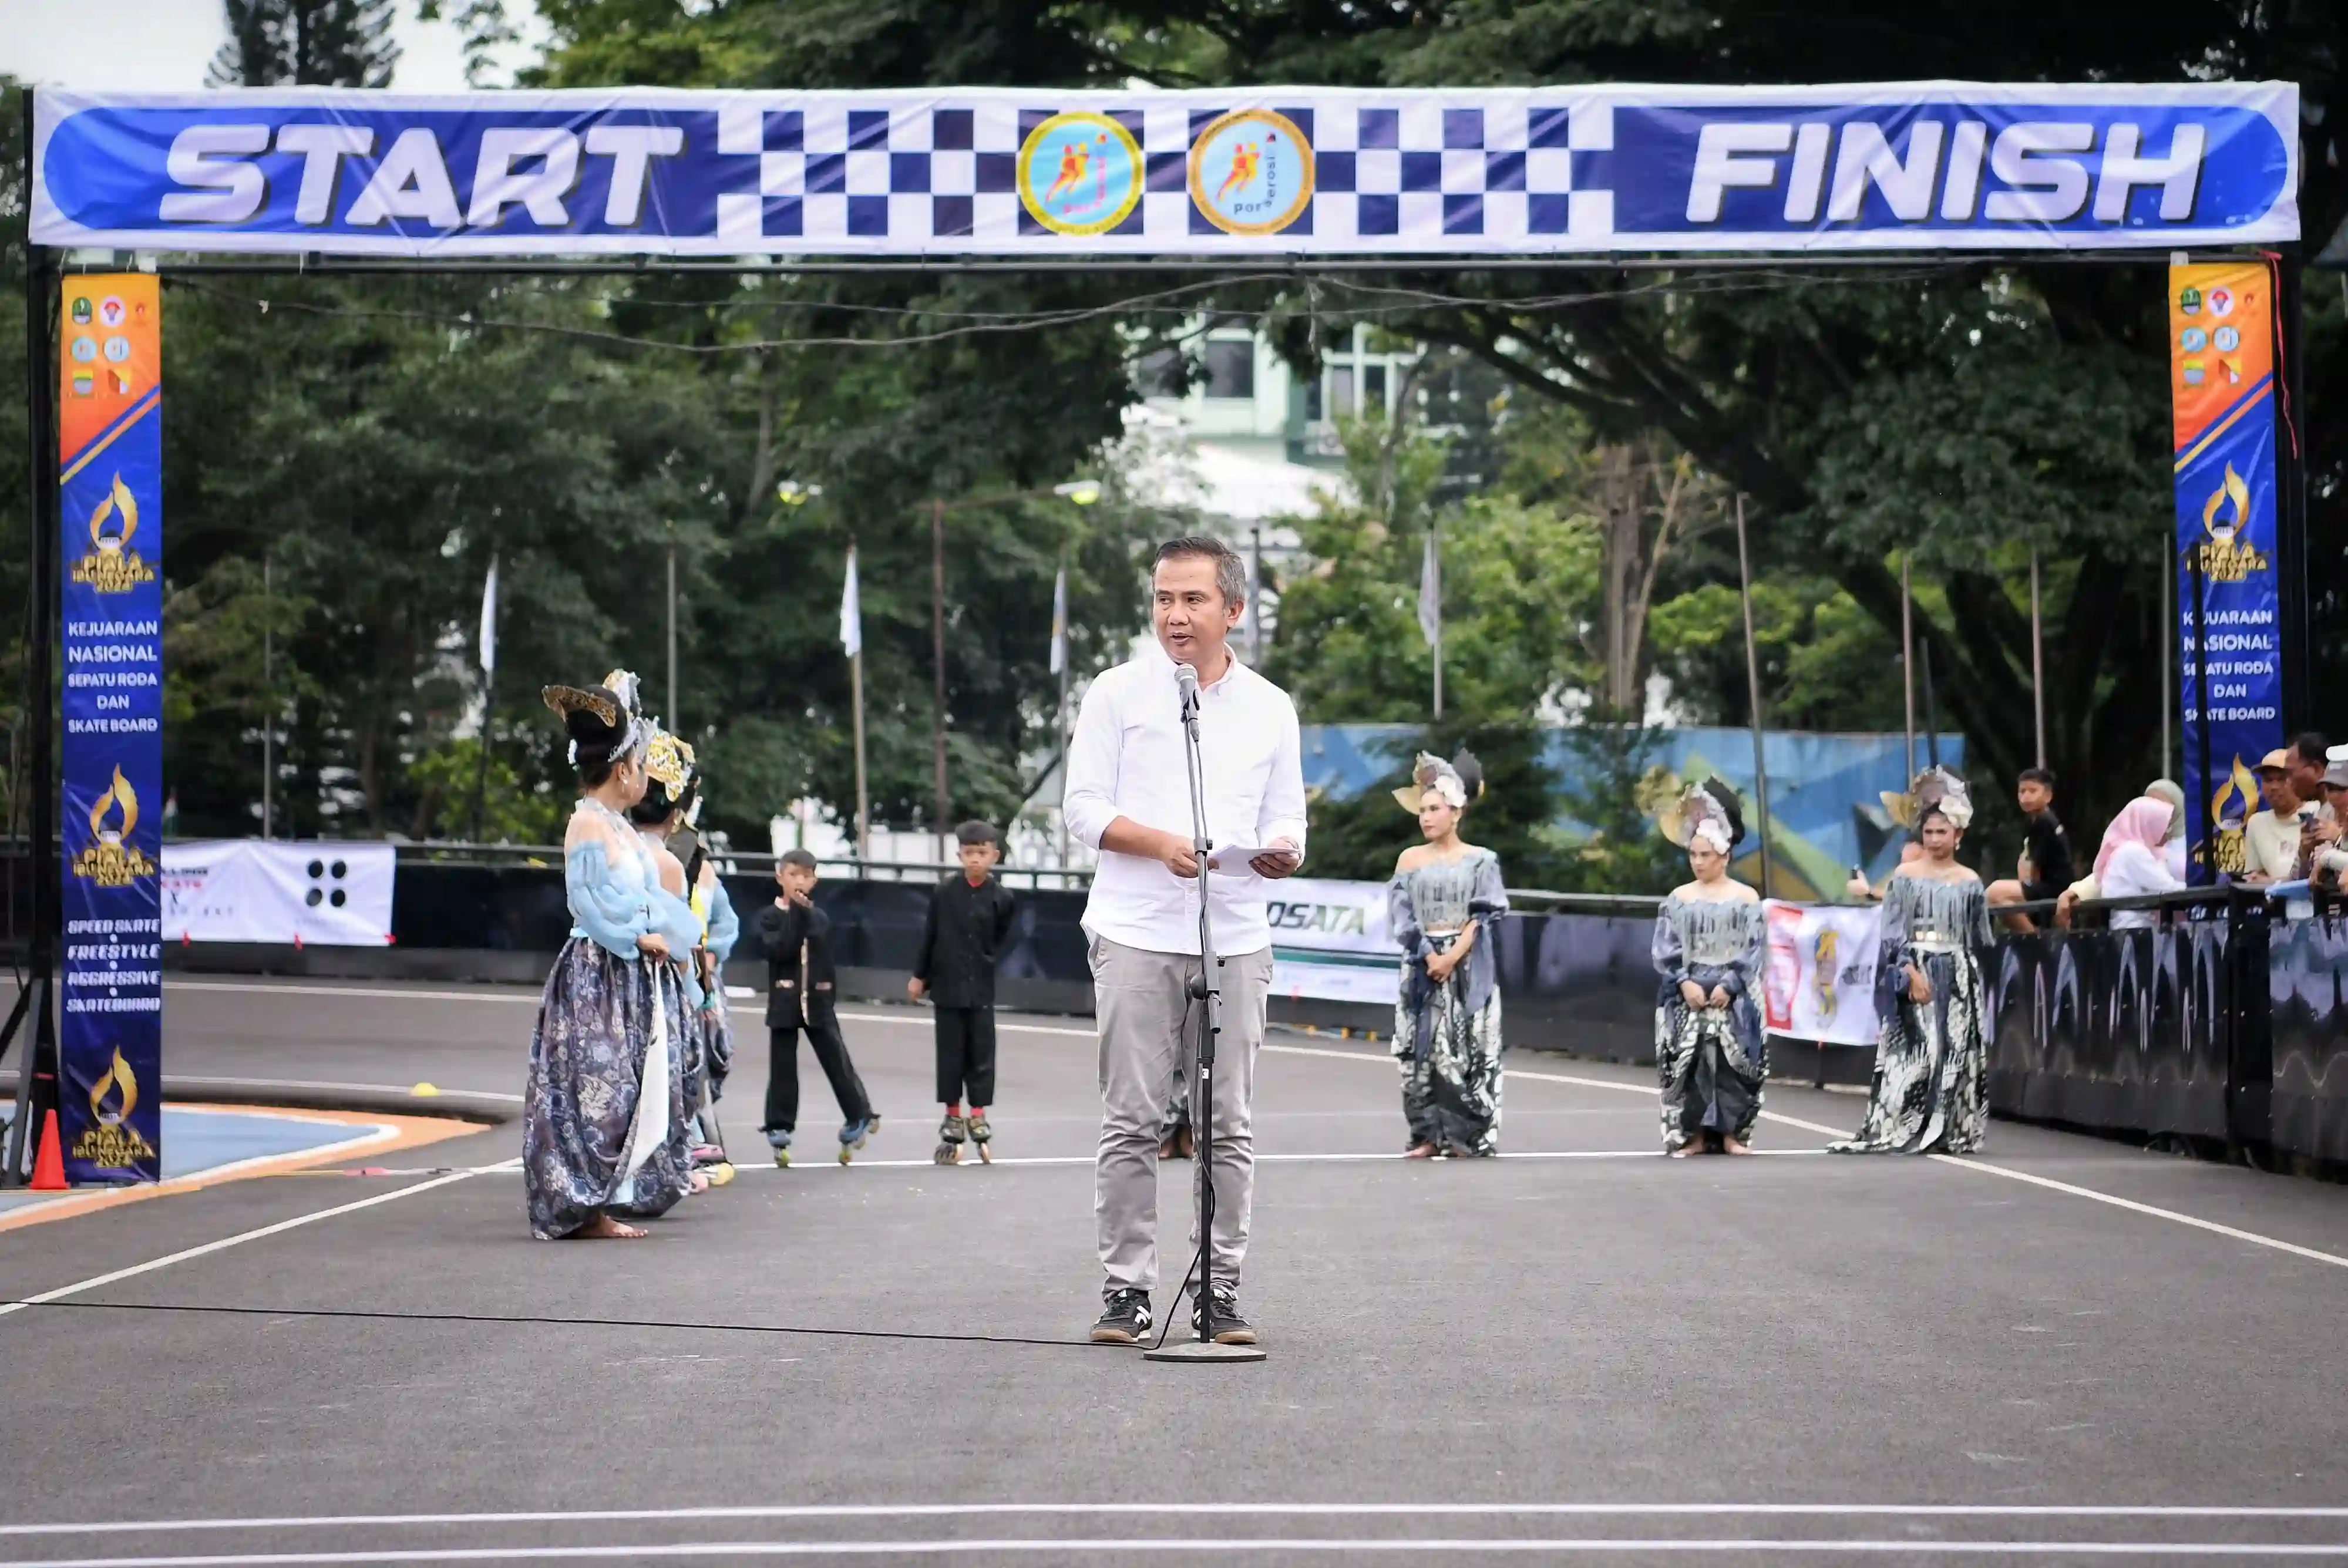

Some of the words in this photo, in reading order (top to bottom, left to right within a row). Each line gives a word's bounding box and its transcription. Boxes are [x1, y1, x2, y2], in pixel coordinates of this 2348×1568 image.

[159, 125, 684, 226] START
[1686, 120, 2205, 221] FINISH
[2183, 609, 2272, 626] KJUARAAN
[68, 620, 157, 637] KEJUARAAN
[68, 645, 157, 662] NASIONAL
[2184, 662, 2232, 676] SEATU
[2234, 661, 2273, 675] RODA
[68, 673, 115, 688] SEPATU
[117, 672, 157, 687] RODA
[2214, 684, 2246, 698] DAN
[97, 694, 129, 710] DAN
[2228, 706, 2275, 721] BOARD
[68, 718, 109, 733] SKATE
[110, 717, 158, 732] BOARD
[68, 920, 113, 934] SPEED
[115, 918, 160, 933] SKATE
[68, 944, 161, 960] FREESTYLE
